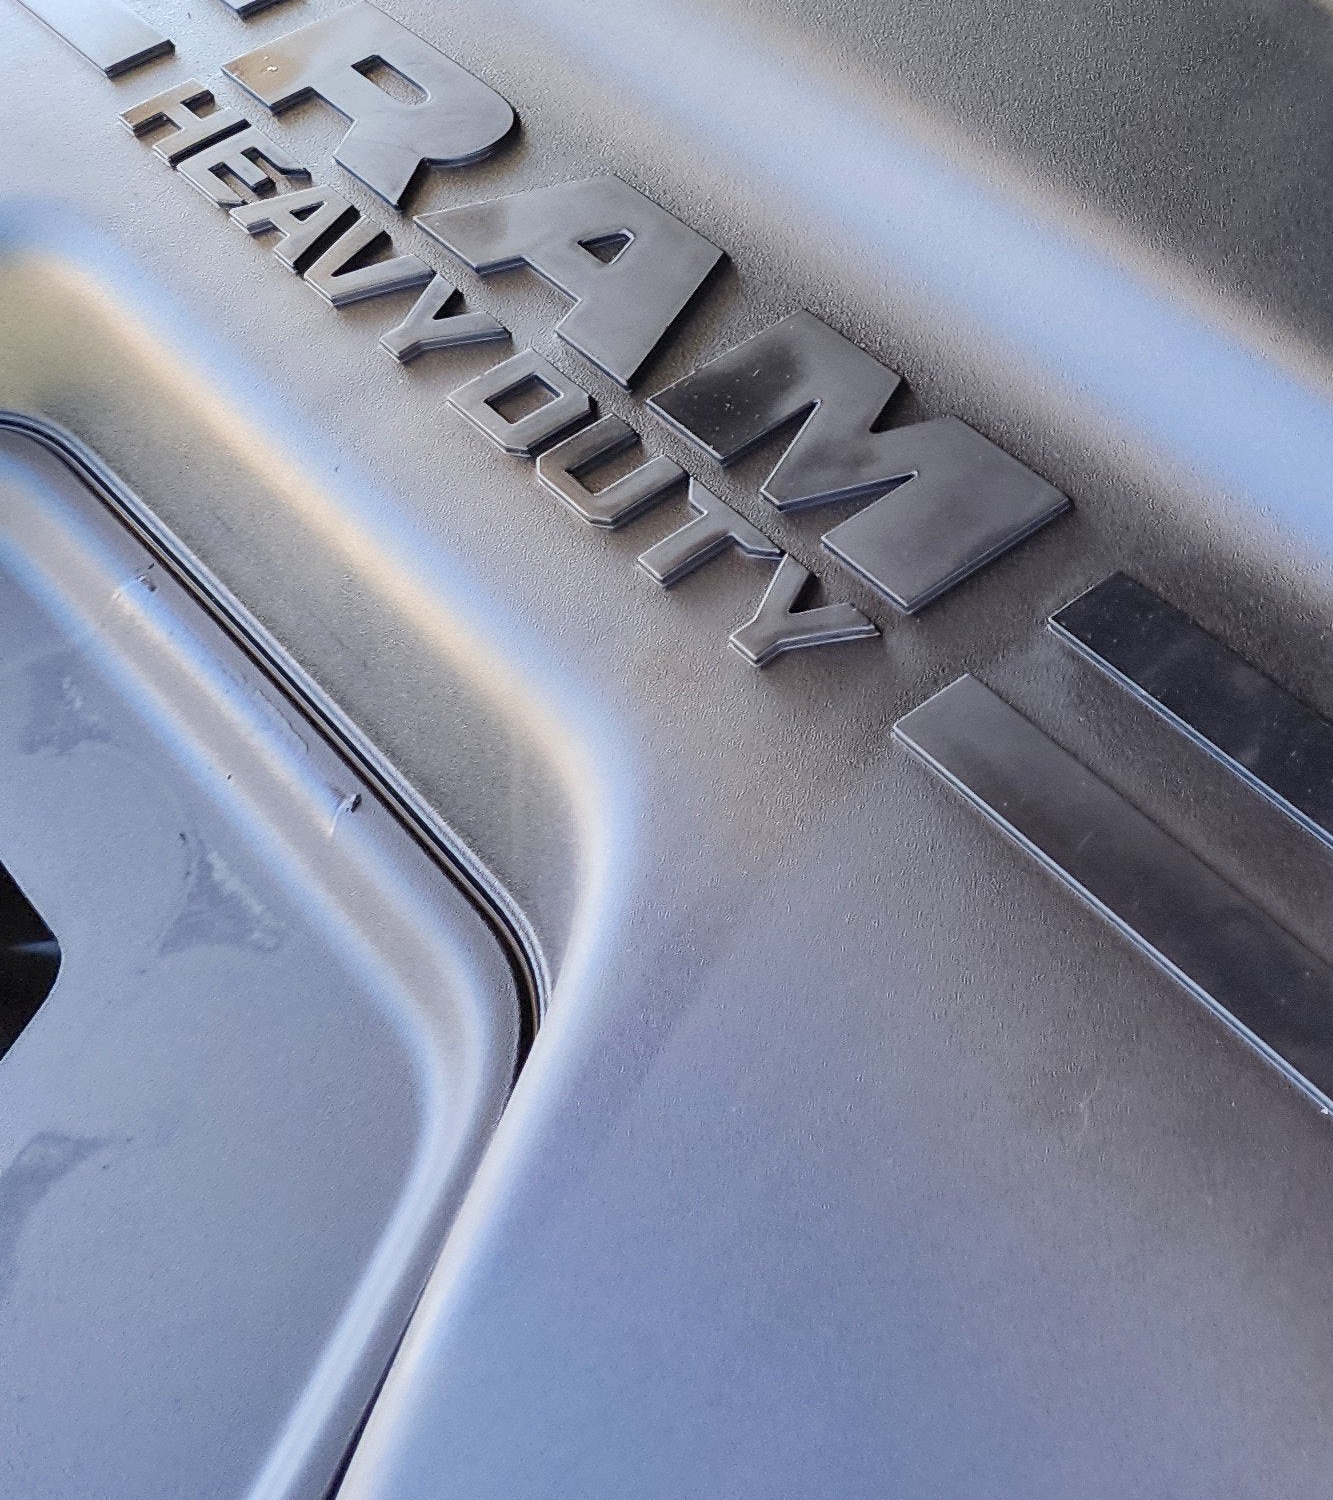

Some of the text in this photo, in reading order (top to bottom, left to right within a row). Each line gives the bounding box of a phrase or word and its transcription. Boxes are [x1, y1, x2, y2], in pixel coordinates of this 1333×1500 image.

[118, 78, 883, 668] HEAVY DUTY
[221, 0, 1073, 615] RAM
